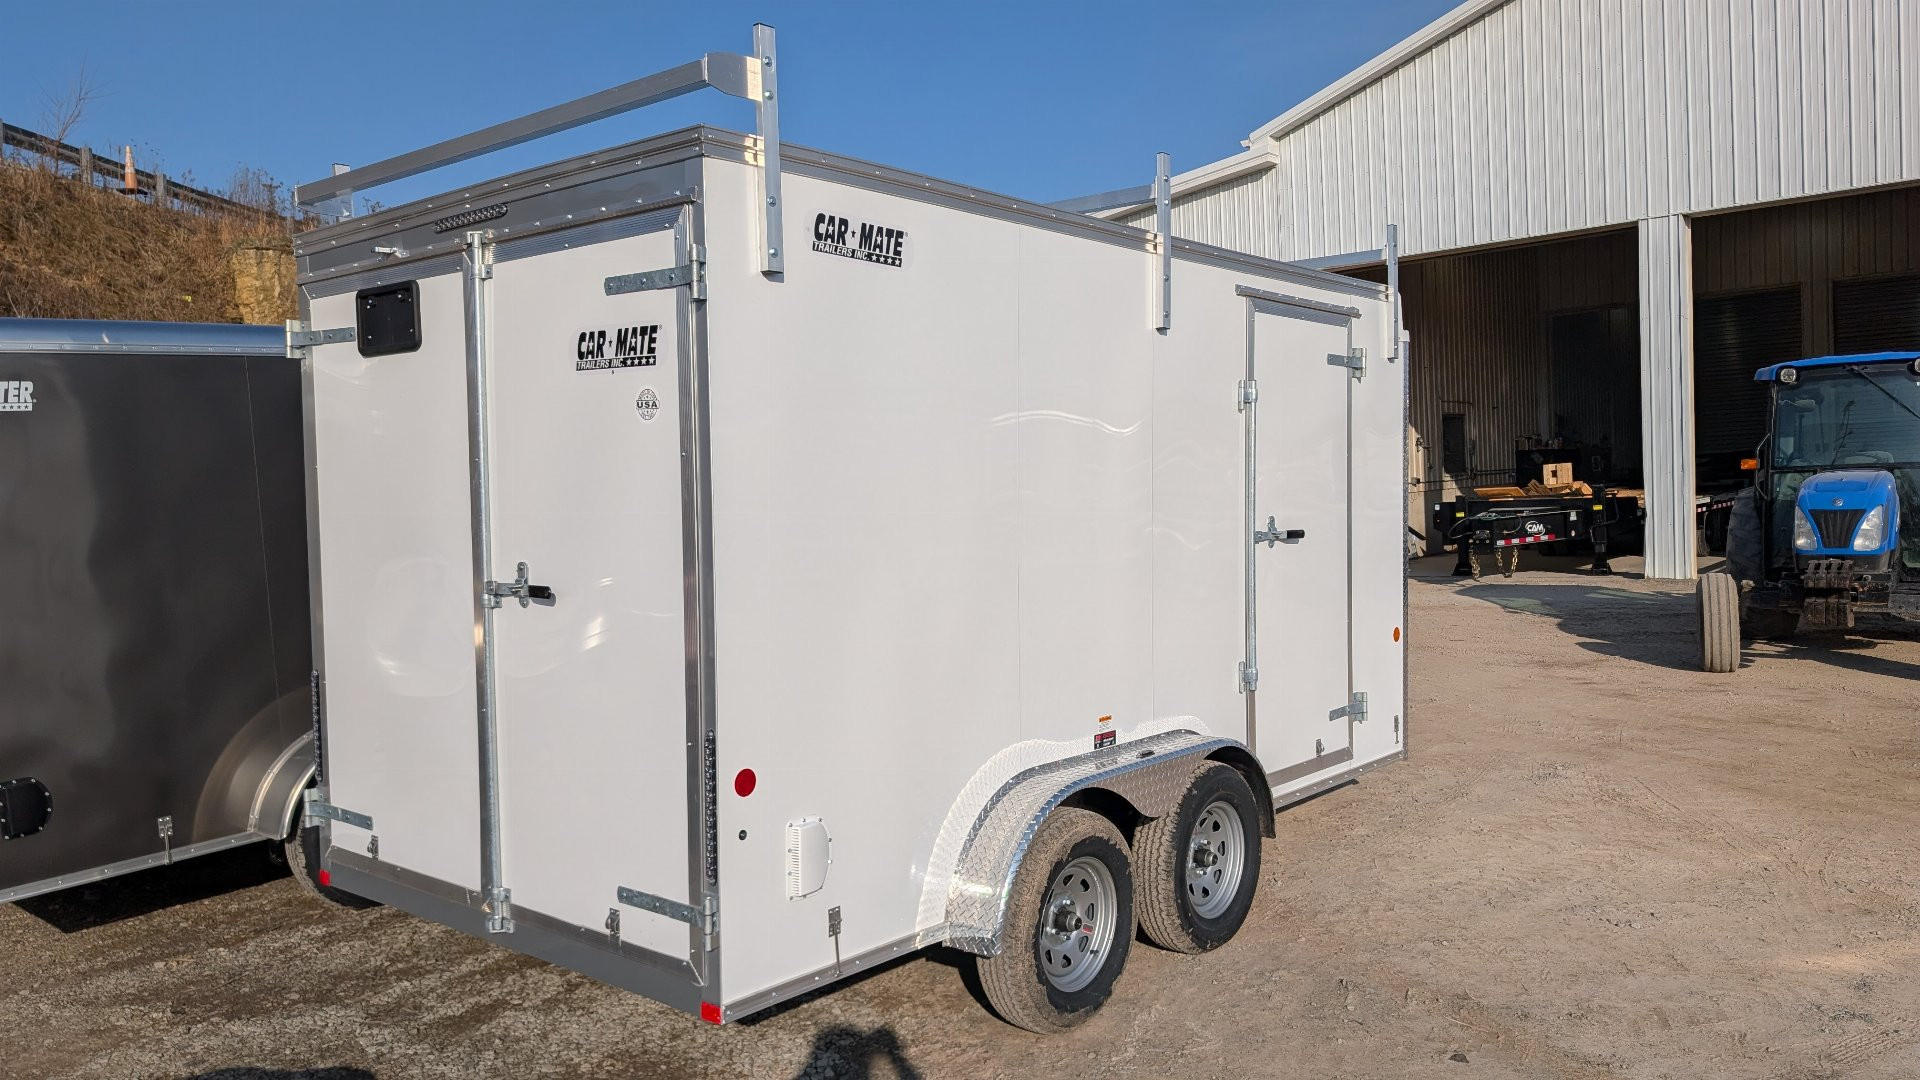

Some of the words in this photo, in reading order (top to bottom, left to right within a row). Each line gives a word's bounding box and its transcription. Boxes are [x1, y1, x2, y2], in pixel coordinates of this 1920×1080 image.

[814, 213, 848, 246] CAR
[859, 222, 904, 257] MATE
[812, 241, 852, 257] TRAILERS
[854, 249, 870, 261] INC.
[577, 330, 606, 360] CAR
[615, 325, 658, 357] MATE
[577, 359, 610, 370] TRAILERS
[610, 357, 625, 367] INC.
[1527, 524, 1544, 532] CAM
